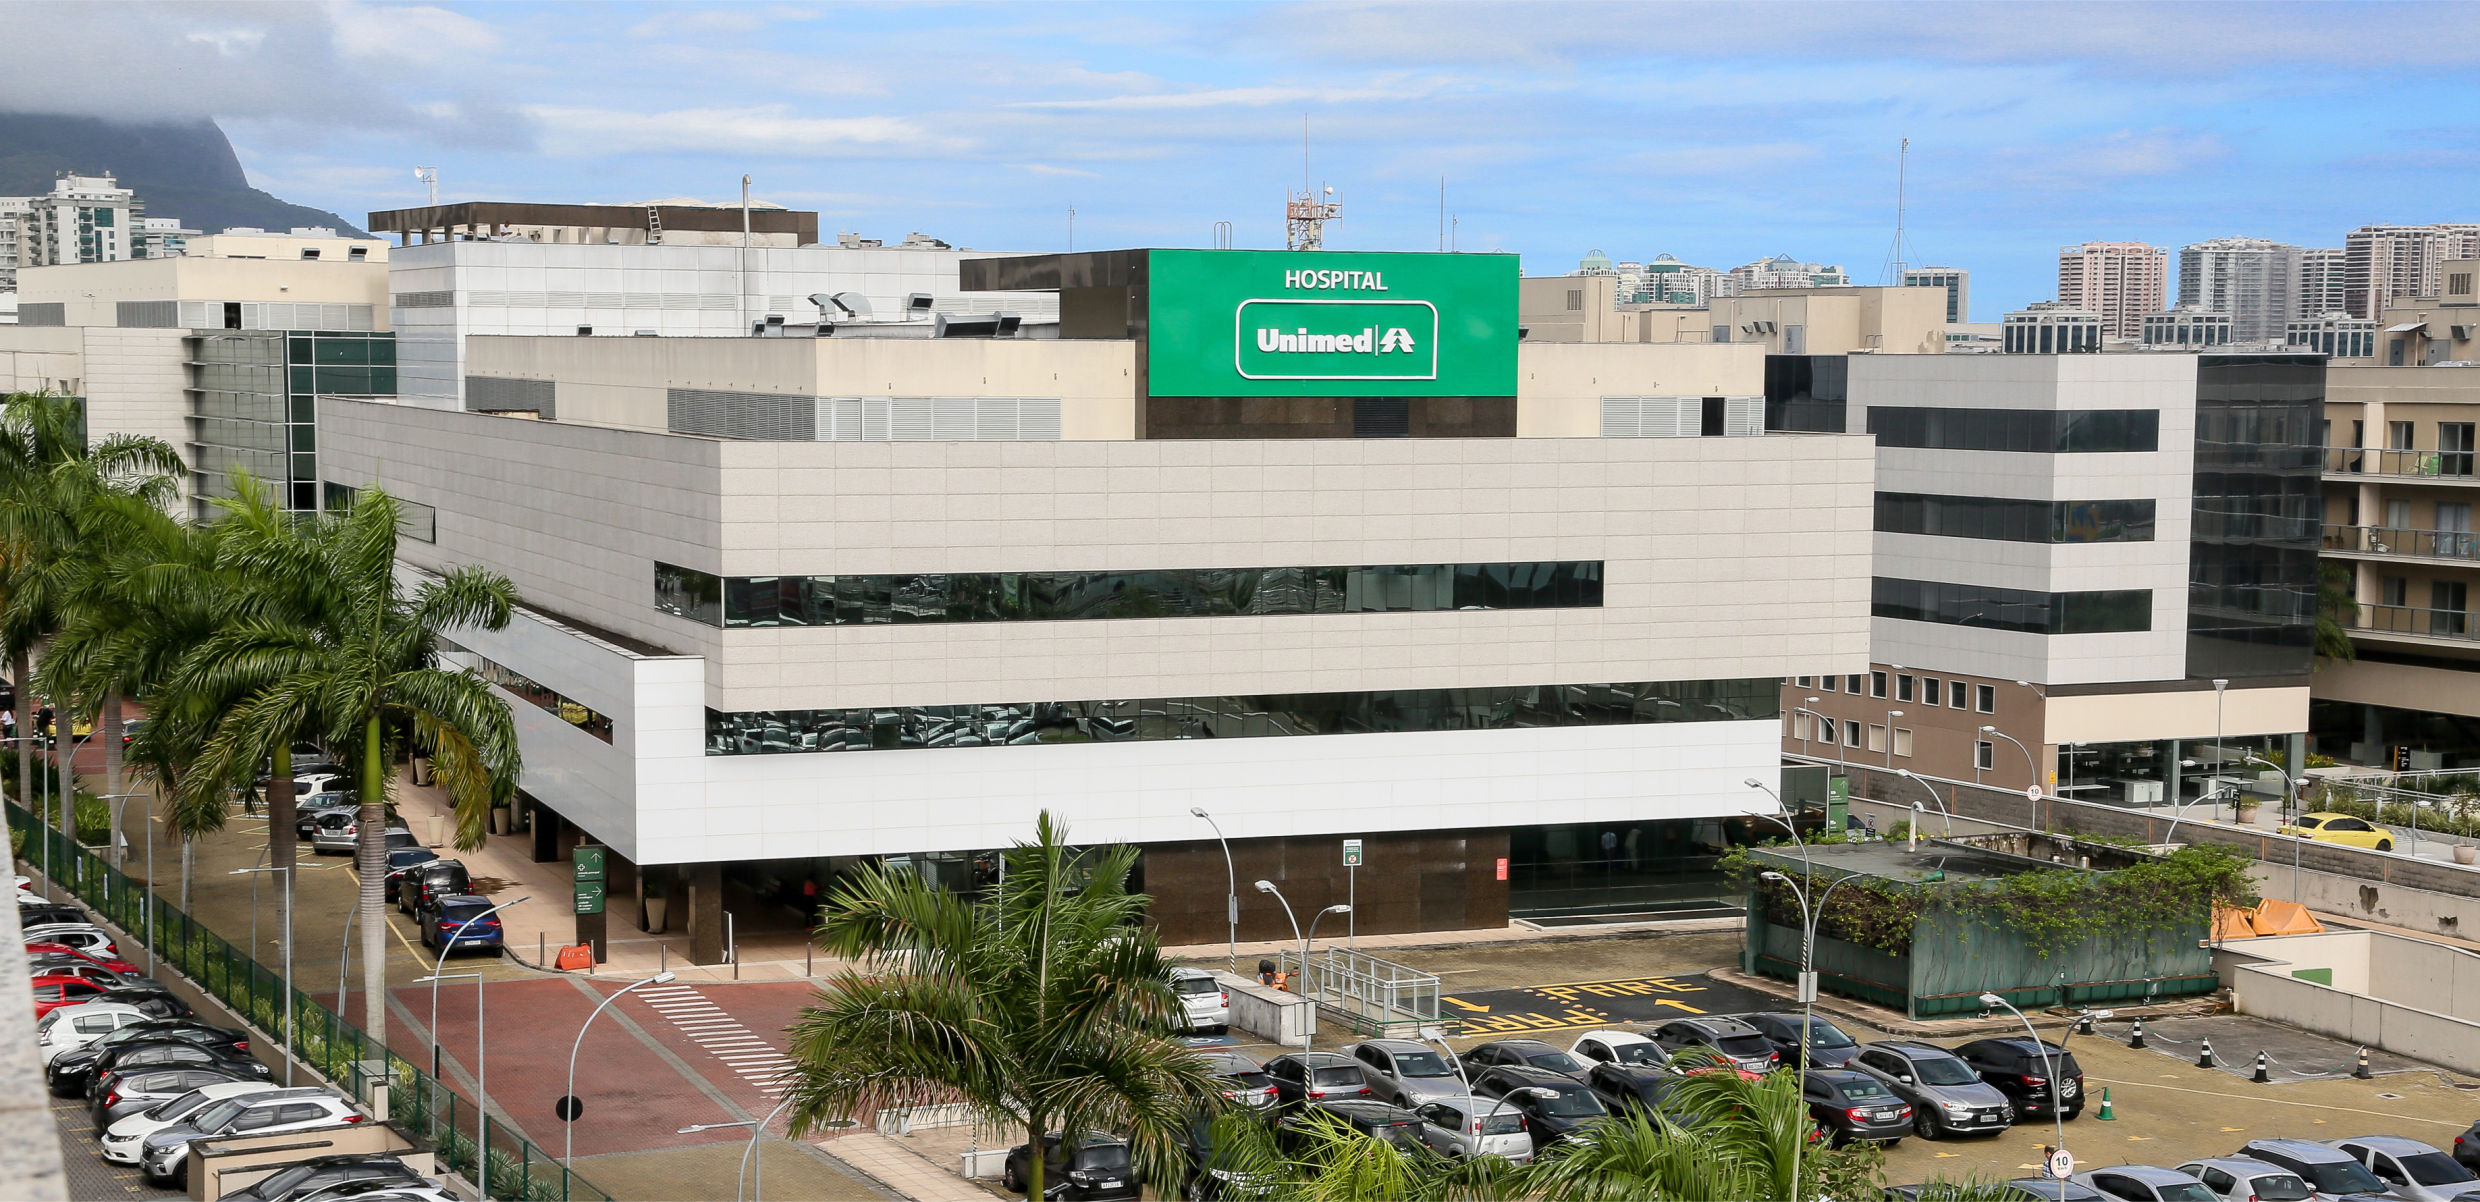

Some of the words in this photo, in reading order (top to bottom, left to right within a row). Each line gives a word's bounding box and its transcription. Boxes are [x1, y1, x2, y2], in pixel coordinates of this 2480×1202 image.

[1285, 269, 1388, 290] HOSPITAL
[1257, 327, 1373, 353] Unimed
[1540, 978, 1708, 1001] PARE
[2056, 1156, 2068, 1166] 10
